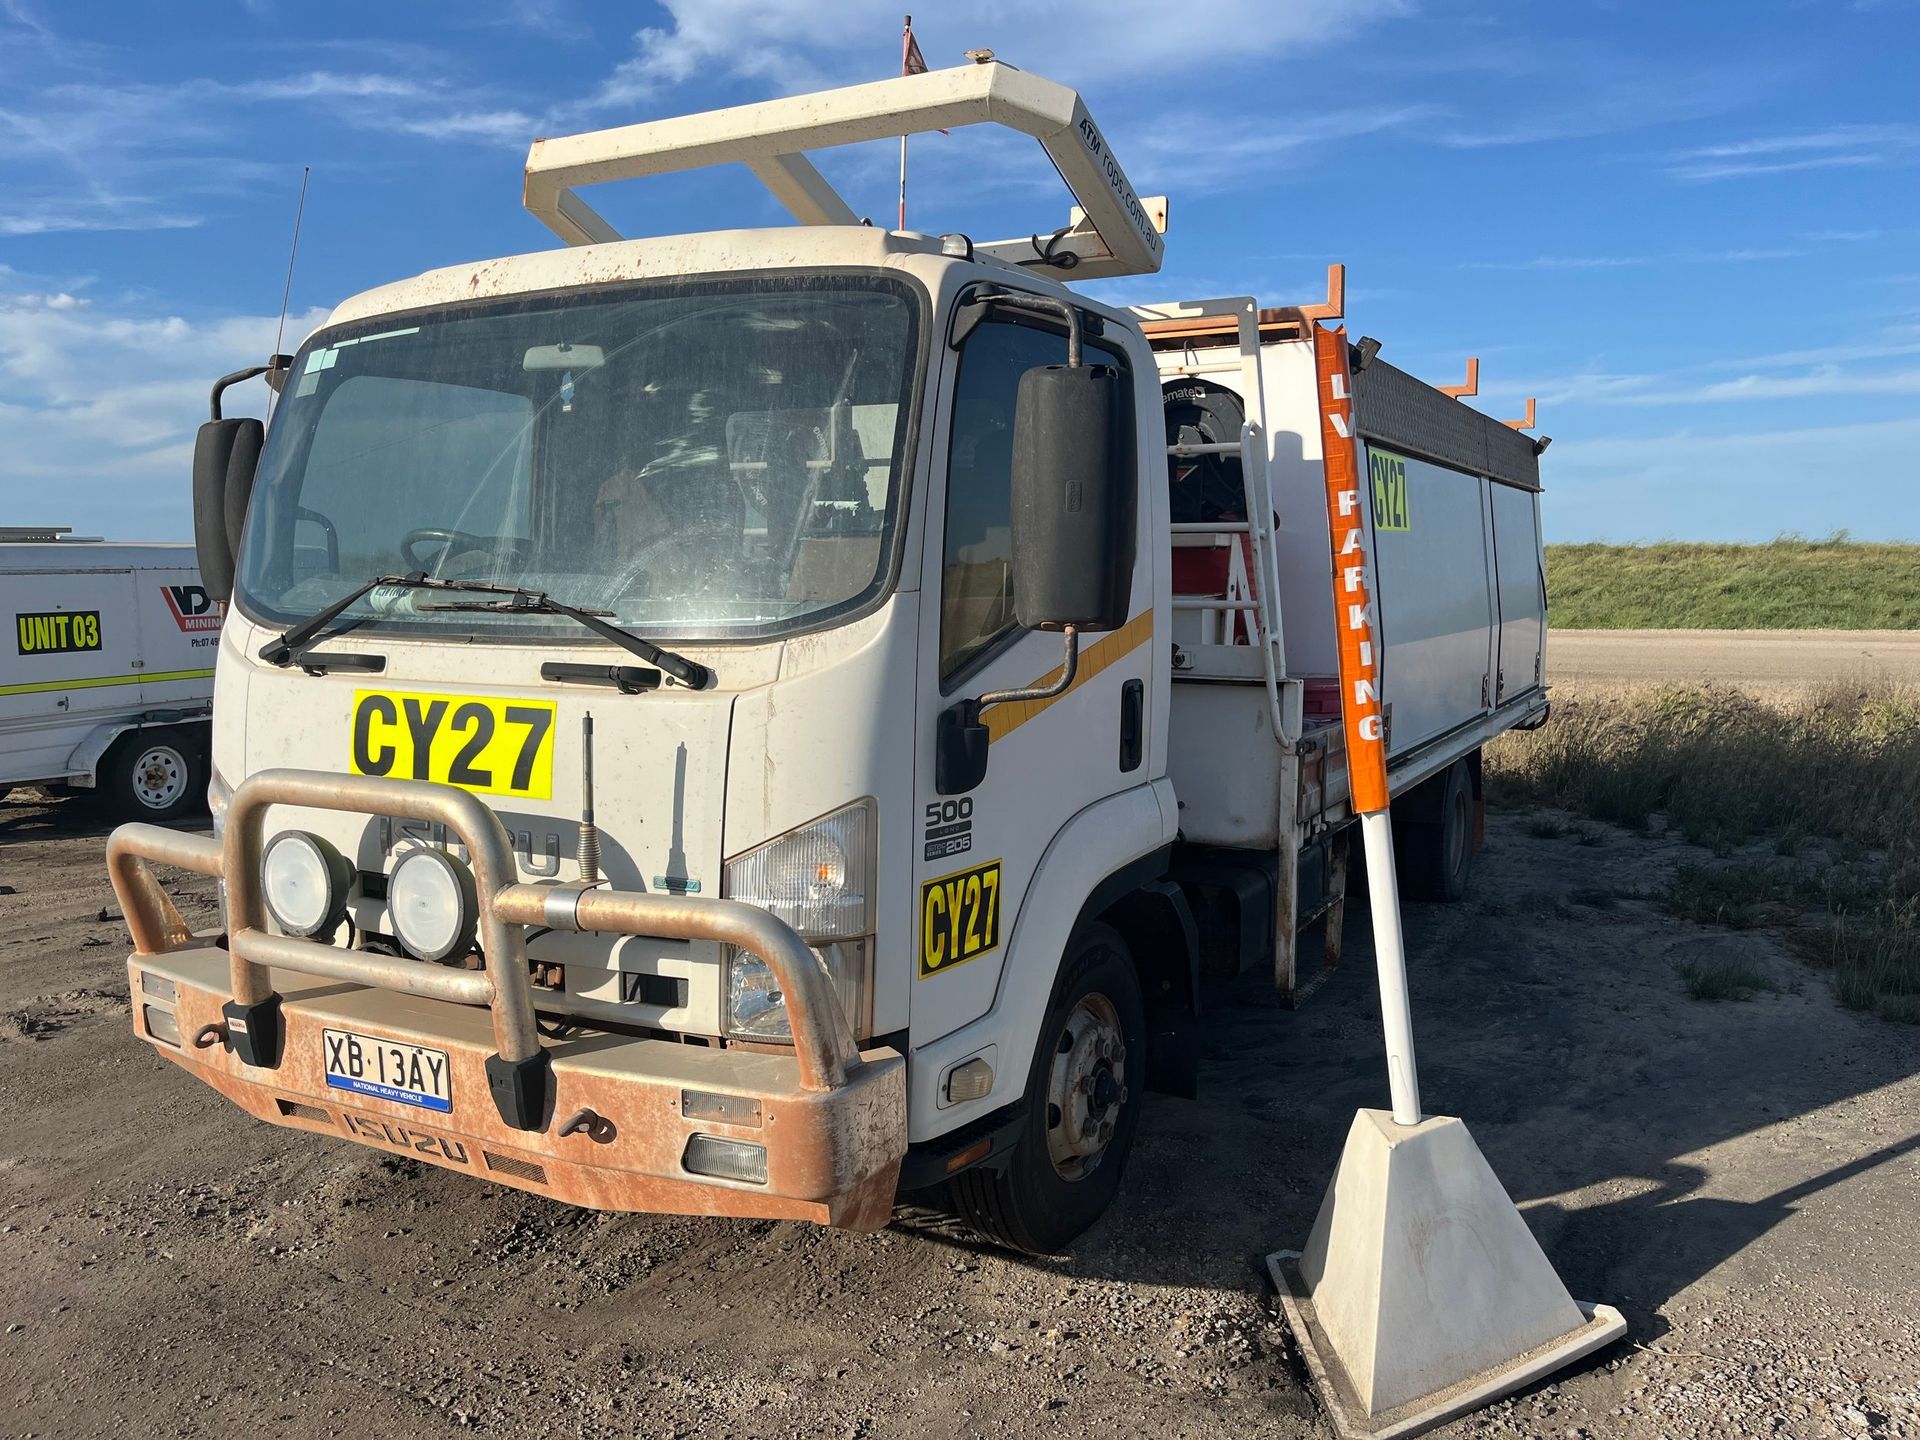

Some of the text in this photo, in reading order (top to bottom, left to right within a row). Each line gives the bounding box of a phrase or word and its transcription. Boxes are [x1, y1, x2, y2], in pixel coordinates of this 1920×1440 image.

[1079, 118, 1157, 252] ATM rops.com.au
[1371, 451, 1409, 530] CY27
[1327, 373, 1384, 742] LV PARKING
[20, 614, 99, 651] UNIT 03
[210, 638, 219, 647] 49
[353, 694, 553, 791] CY27
[925, 796, 973, 827] 500
[946, 836, 971, 854] 205
[925, 868, 999, 969] CY27
[353, 1081, 423, 1103] NATIONAL HEAVY VEHICLE
[343, 1113, 469, 1165] ISUZU
